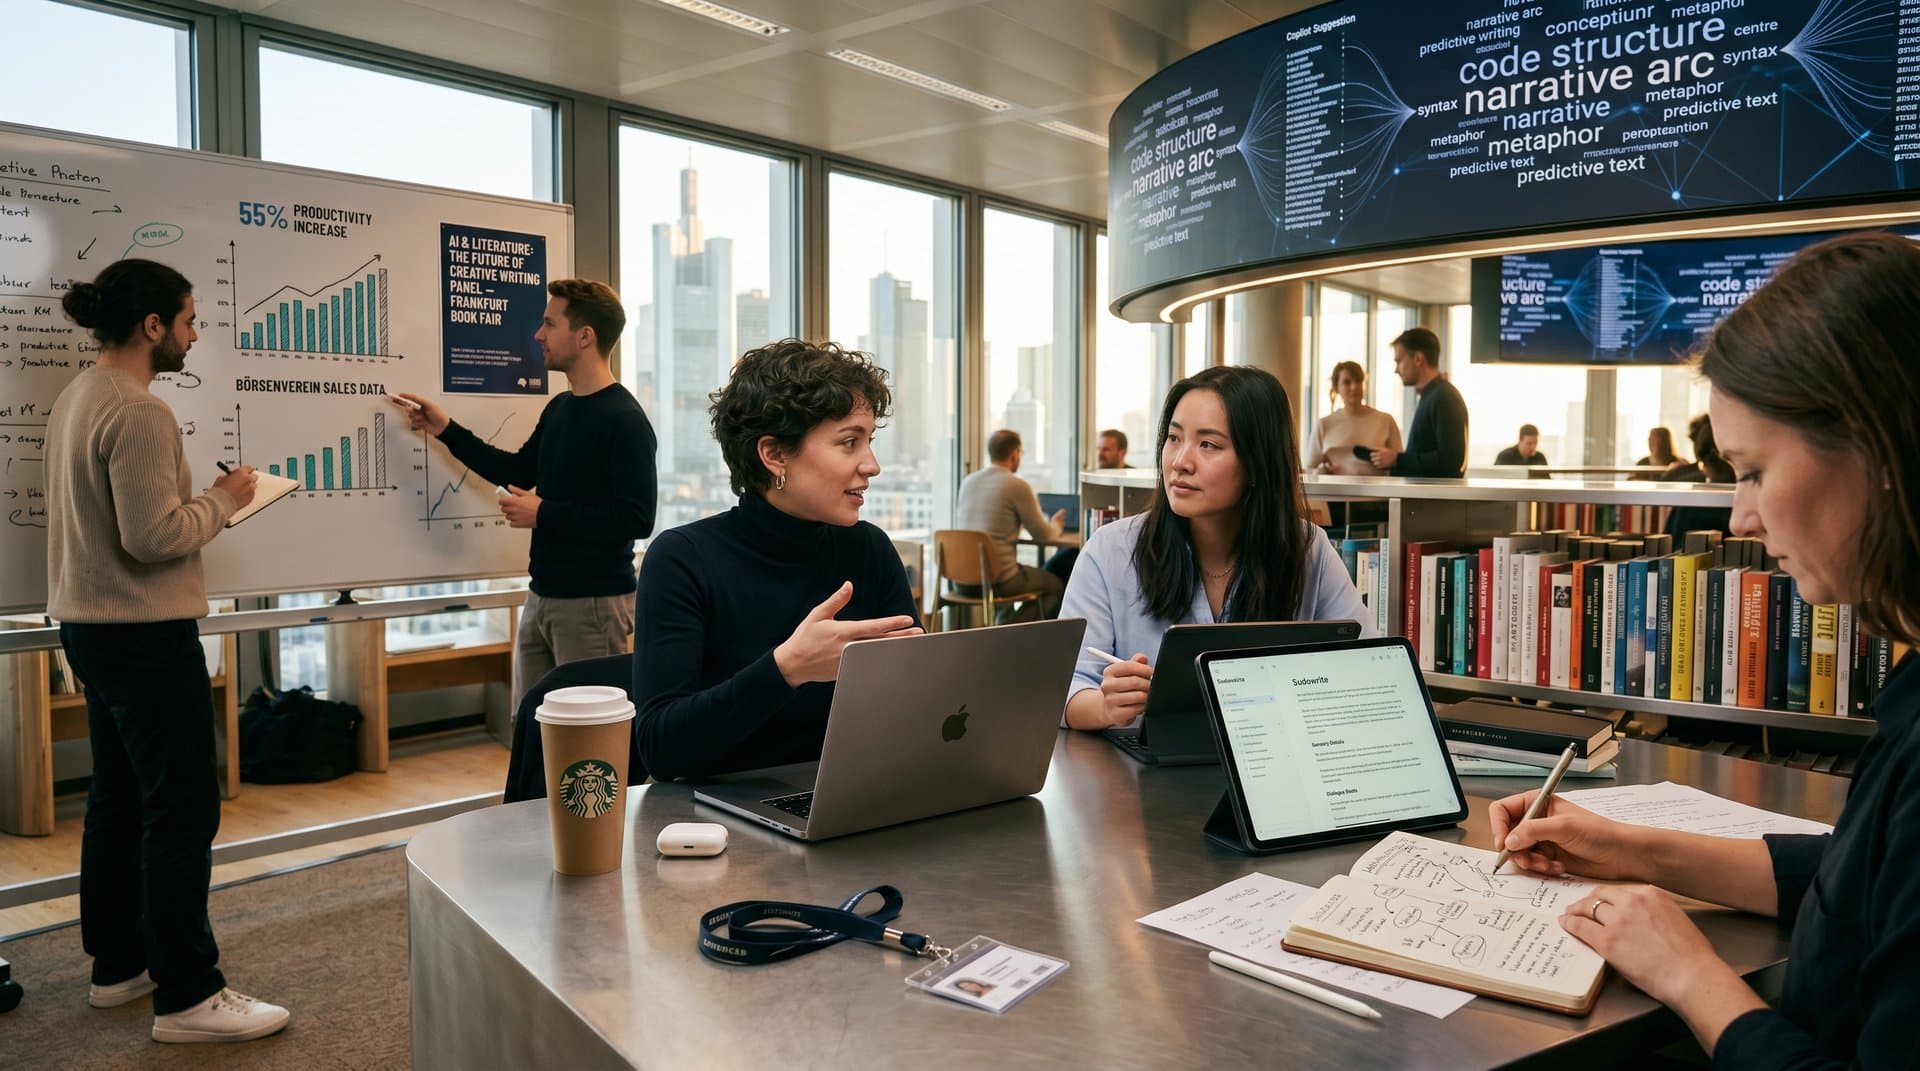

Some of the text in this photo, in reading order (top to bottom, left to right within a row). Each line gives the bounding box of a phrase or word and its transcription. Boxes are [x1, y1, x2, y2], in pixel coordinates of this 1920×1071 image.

[1286, 14, 1356, 41] Copilot Suggestion
[1466, 6, 1543, 31] narrative arc
[1733, 20, 1778, 37] centre
[1419, 34, 1476, 58] predictive
[1478, 25, 1520, 42] writing
[1459, 17, 1725, 85] code structure
[1722, 44, 1778, 66] syntax
[1465, 52, 1715, 115] narrative arc
[1645, 81, 1724, 103] metaphor
[1417, 99, 1458, 118] syntax
[1503, 99, 1611, 131] narrative
[1663, 91, 1778, 122] predictive text
[1430, 129, 1485, 147] metaphor
[1488, 125, 1604, 157] metaphor
[1130, 146, 1153, 175] code
[1155, 123, 1217, 162] structure
[1132, 148, 1215, 198] narrative arc
[1450, 155, 1535, 179] predictive text
[1517, 155, 1646, 188] predictive text
[239, 201, 373, 230] 55% PRODUCTIVITY
[294, 220, 347, 238] INCREASE
[449, 235, 534, 256] AI & LITERATURE:
[449, 250, 525, 269] THE FUTURE OF
[450, 265, 541, 286] CREATIVE WRITING
[1501, 277, 1546, 292] ucture
[1700, 276, 1741, 291] code
[450, 280, 483, 295] PANEL
[450, 295, 509, 311] FRANKFURT
[1520, 293, 1544, 305] arc
[451, 310, 502, 326] BOOK FAIR
[236, 376, 387, 396] BÖRSENVEREIN SALES DATA
[1292, 675, 1329, 686] Sudowrite
